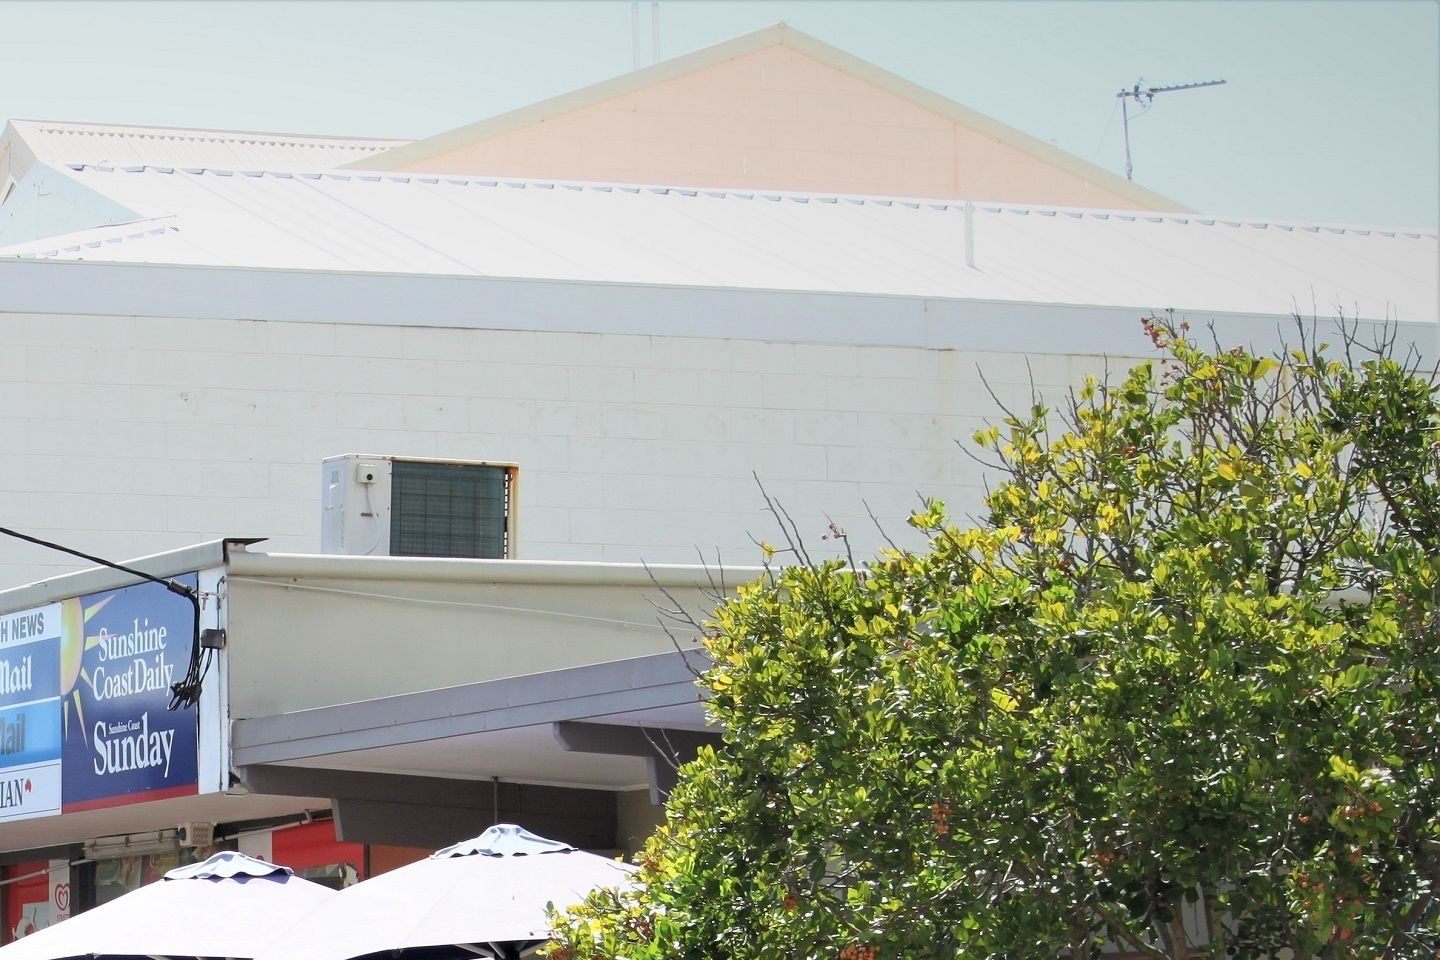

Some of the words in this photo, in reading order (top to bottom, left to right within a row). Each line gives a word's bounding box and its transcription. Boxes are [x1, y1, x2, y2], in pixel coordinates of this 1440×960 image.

[11, 612, 44, 640] NEWS
[98, 618, 167, 662] Sunshine
[93, 712, 175, 778] Sunday
